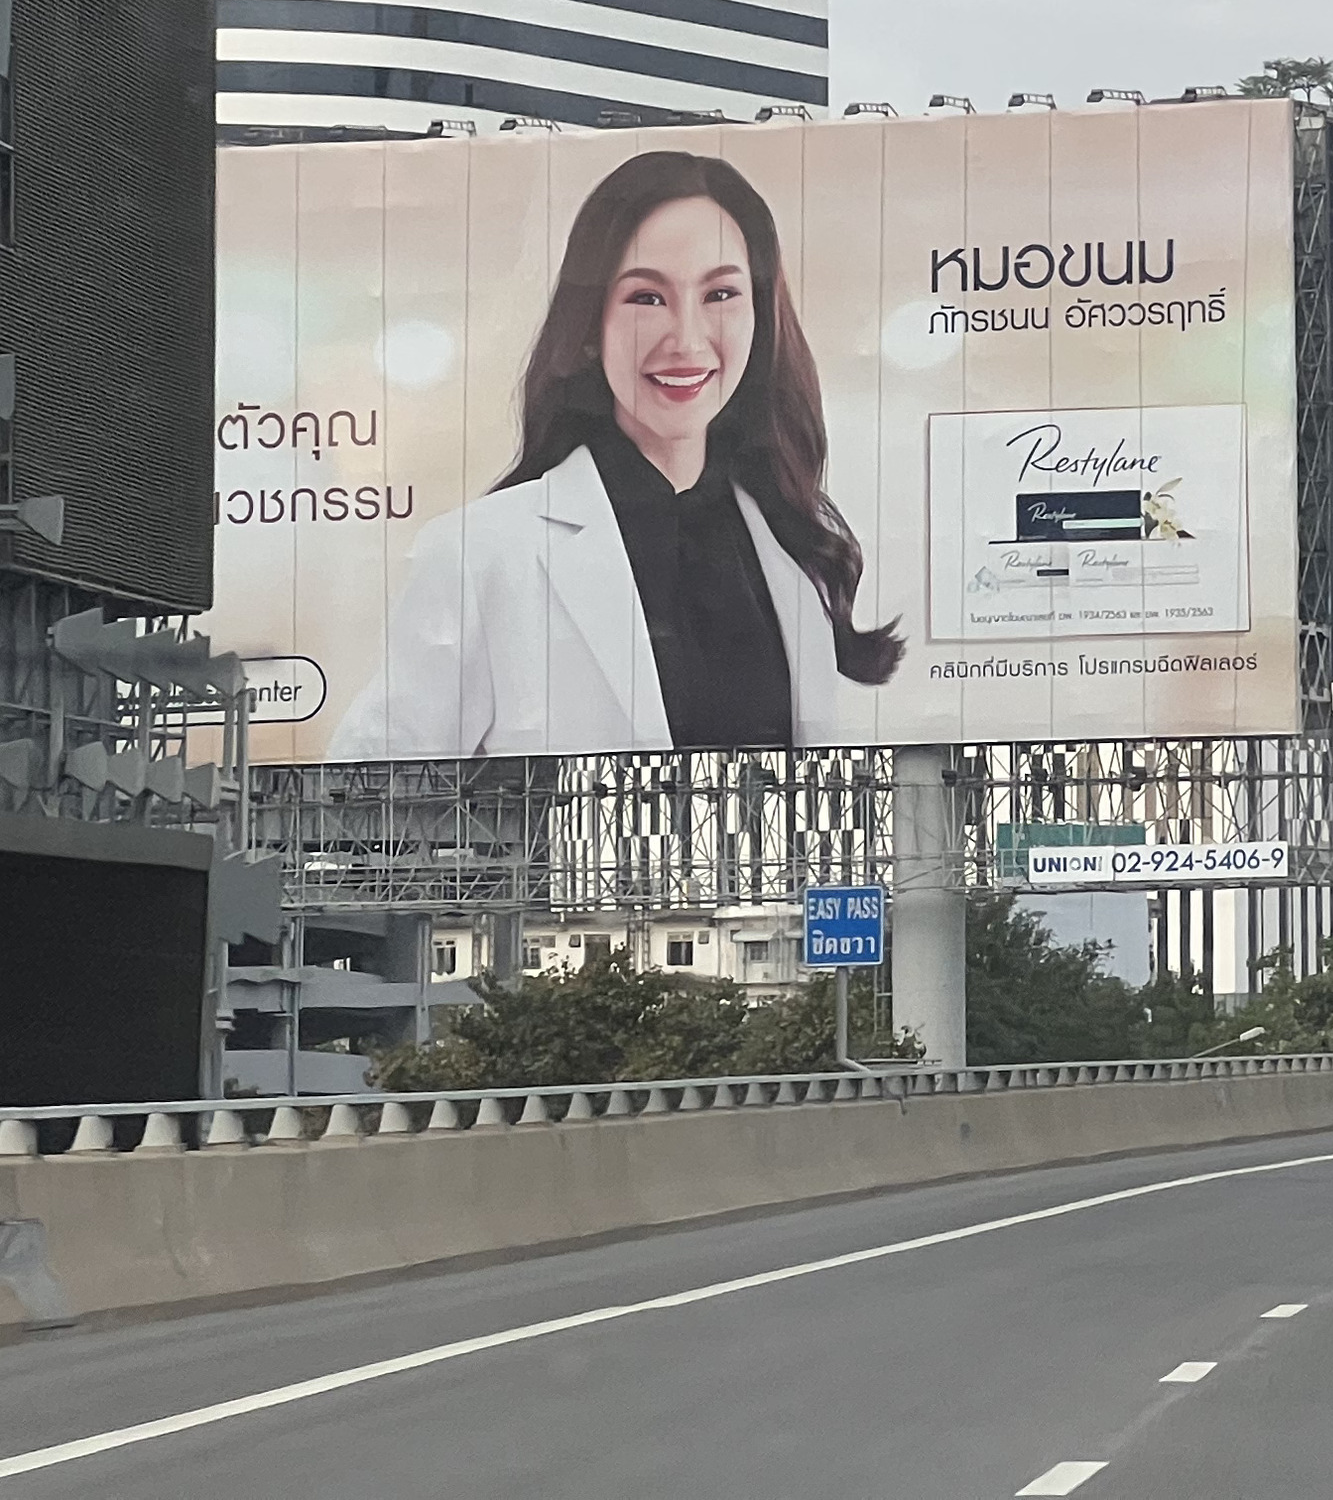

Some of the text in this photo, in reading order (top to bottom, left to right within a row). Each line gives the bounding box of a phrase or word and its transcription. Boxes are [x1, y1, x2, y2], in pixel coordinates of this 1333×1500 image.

[931, 238, 1174, 293] หมอขนม
[928, 304, 1050, 334] ภัทรชนน
[217, 402, 377, 461] ตัวคุณ
[1006, 423, 1159, 488] Restylane
[929, 652, 1258, 679] คลินิกที่มีบริการ โปรแกรมฉีดฟิลเลอร์
[256, 679, 303, 702] nter
[1111, 847, 1284, 873] 02-924-5406-9
[808, 896, 880, 920] EASY PASS
[812, 929, 876, 955] ชิดขวา
